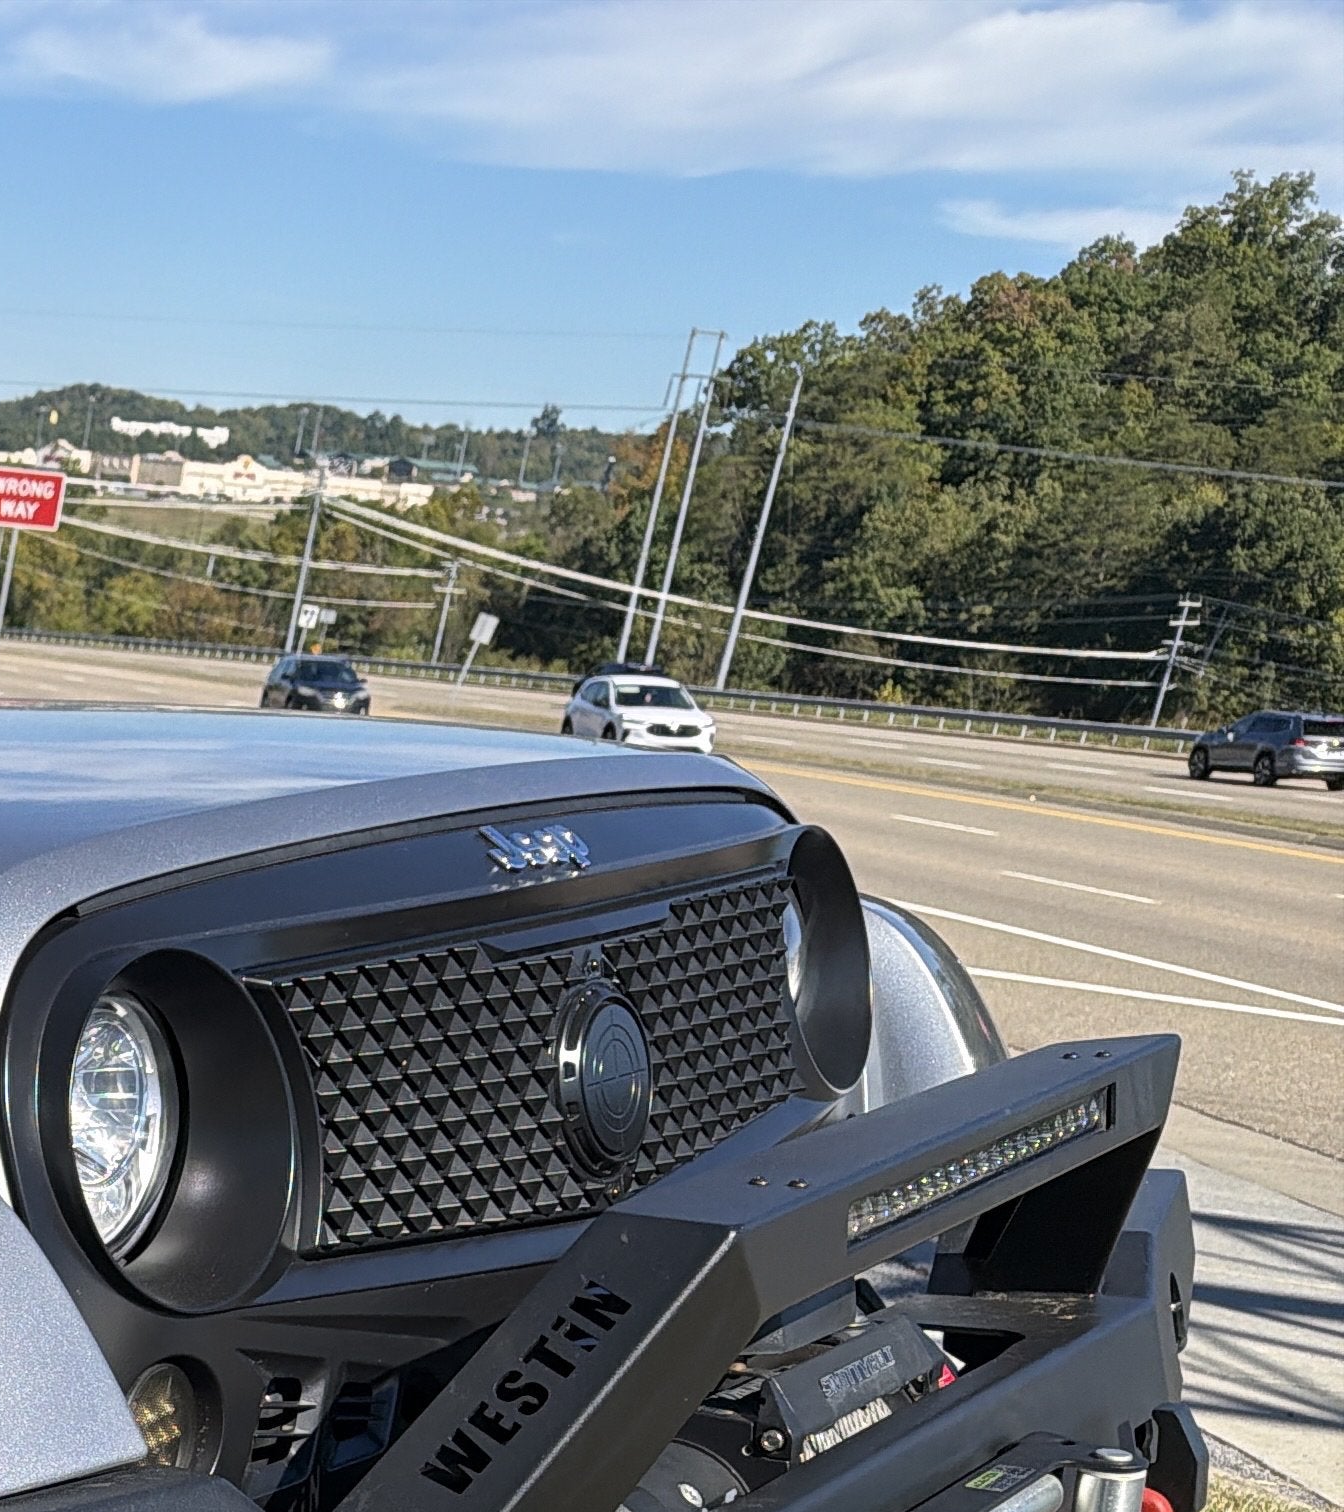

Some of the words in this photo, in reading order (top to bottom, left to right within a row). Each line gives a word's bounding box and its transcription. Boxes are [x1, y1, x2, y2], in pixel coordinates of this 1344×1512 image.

[0, 498, 41, 521] WAY
[478, 824, 592, 870] Jeep
[420, 1279, 632, 1495] WESTIN
